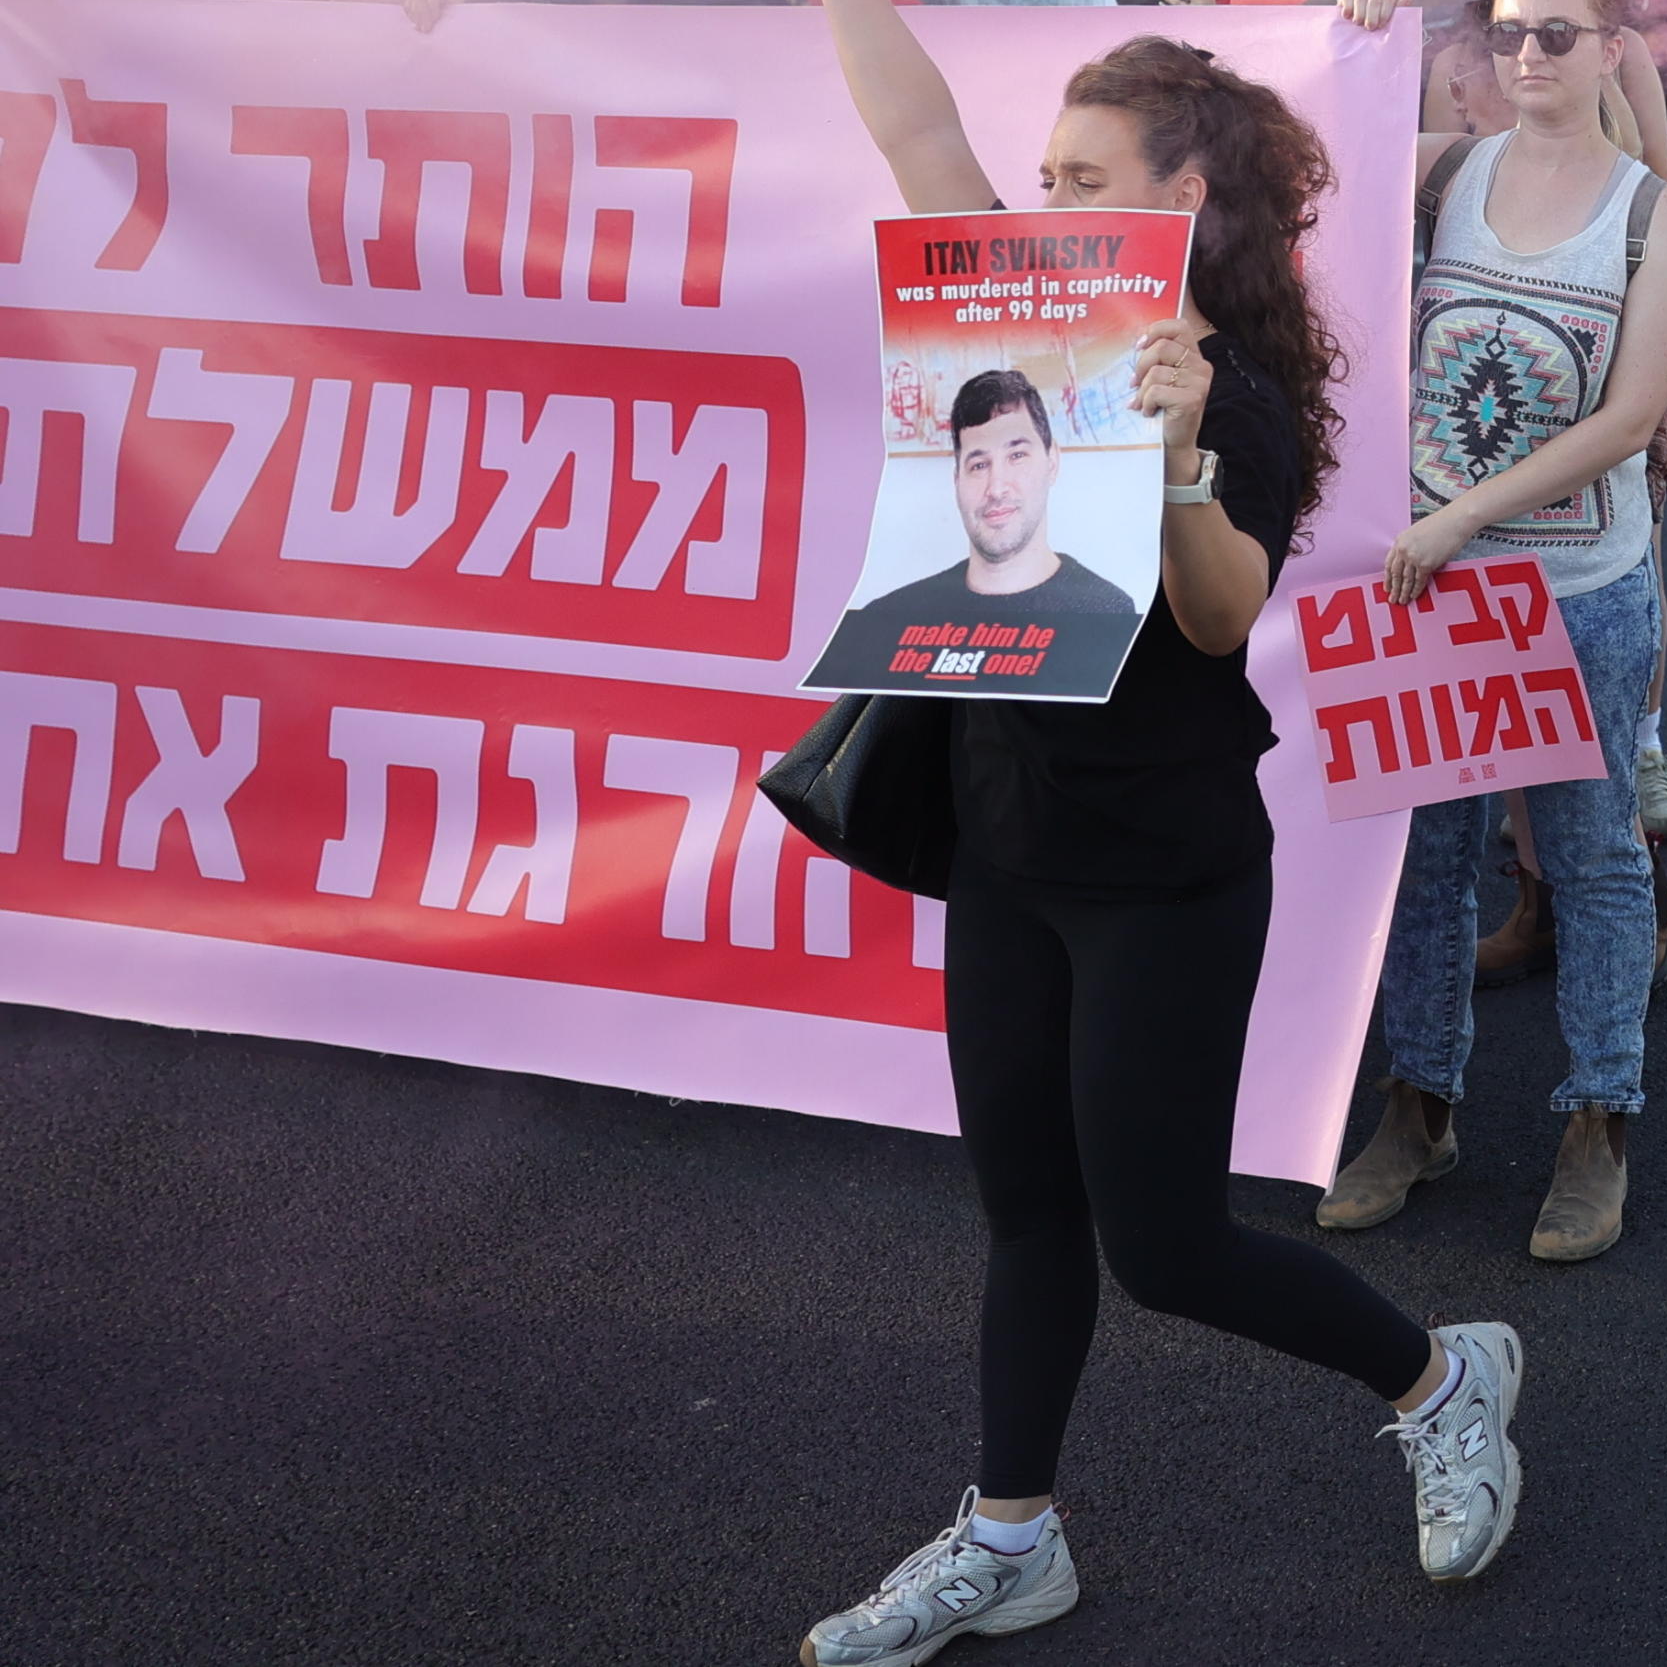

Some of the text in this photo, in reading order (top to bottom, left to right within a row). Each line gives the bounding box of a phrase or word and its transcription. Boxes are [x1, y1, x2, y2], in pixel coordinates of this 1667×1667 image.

[231, 105, 739, 309] הותר
[925, 235, 1125, 275] ITAY SVIRSKY
[897, 273, 1166, 302] was murdered in captivity
[955, 298, 1087, 324] after 99 days
[0, 347, 769, 601] ממשלת
[899, 622, 1055, 649] make him be
[1297, 561, 1549, 673] קבינט
[890, 648, 1043, 676] the last one!
[1316, 667, 1594, 783] המוות
